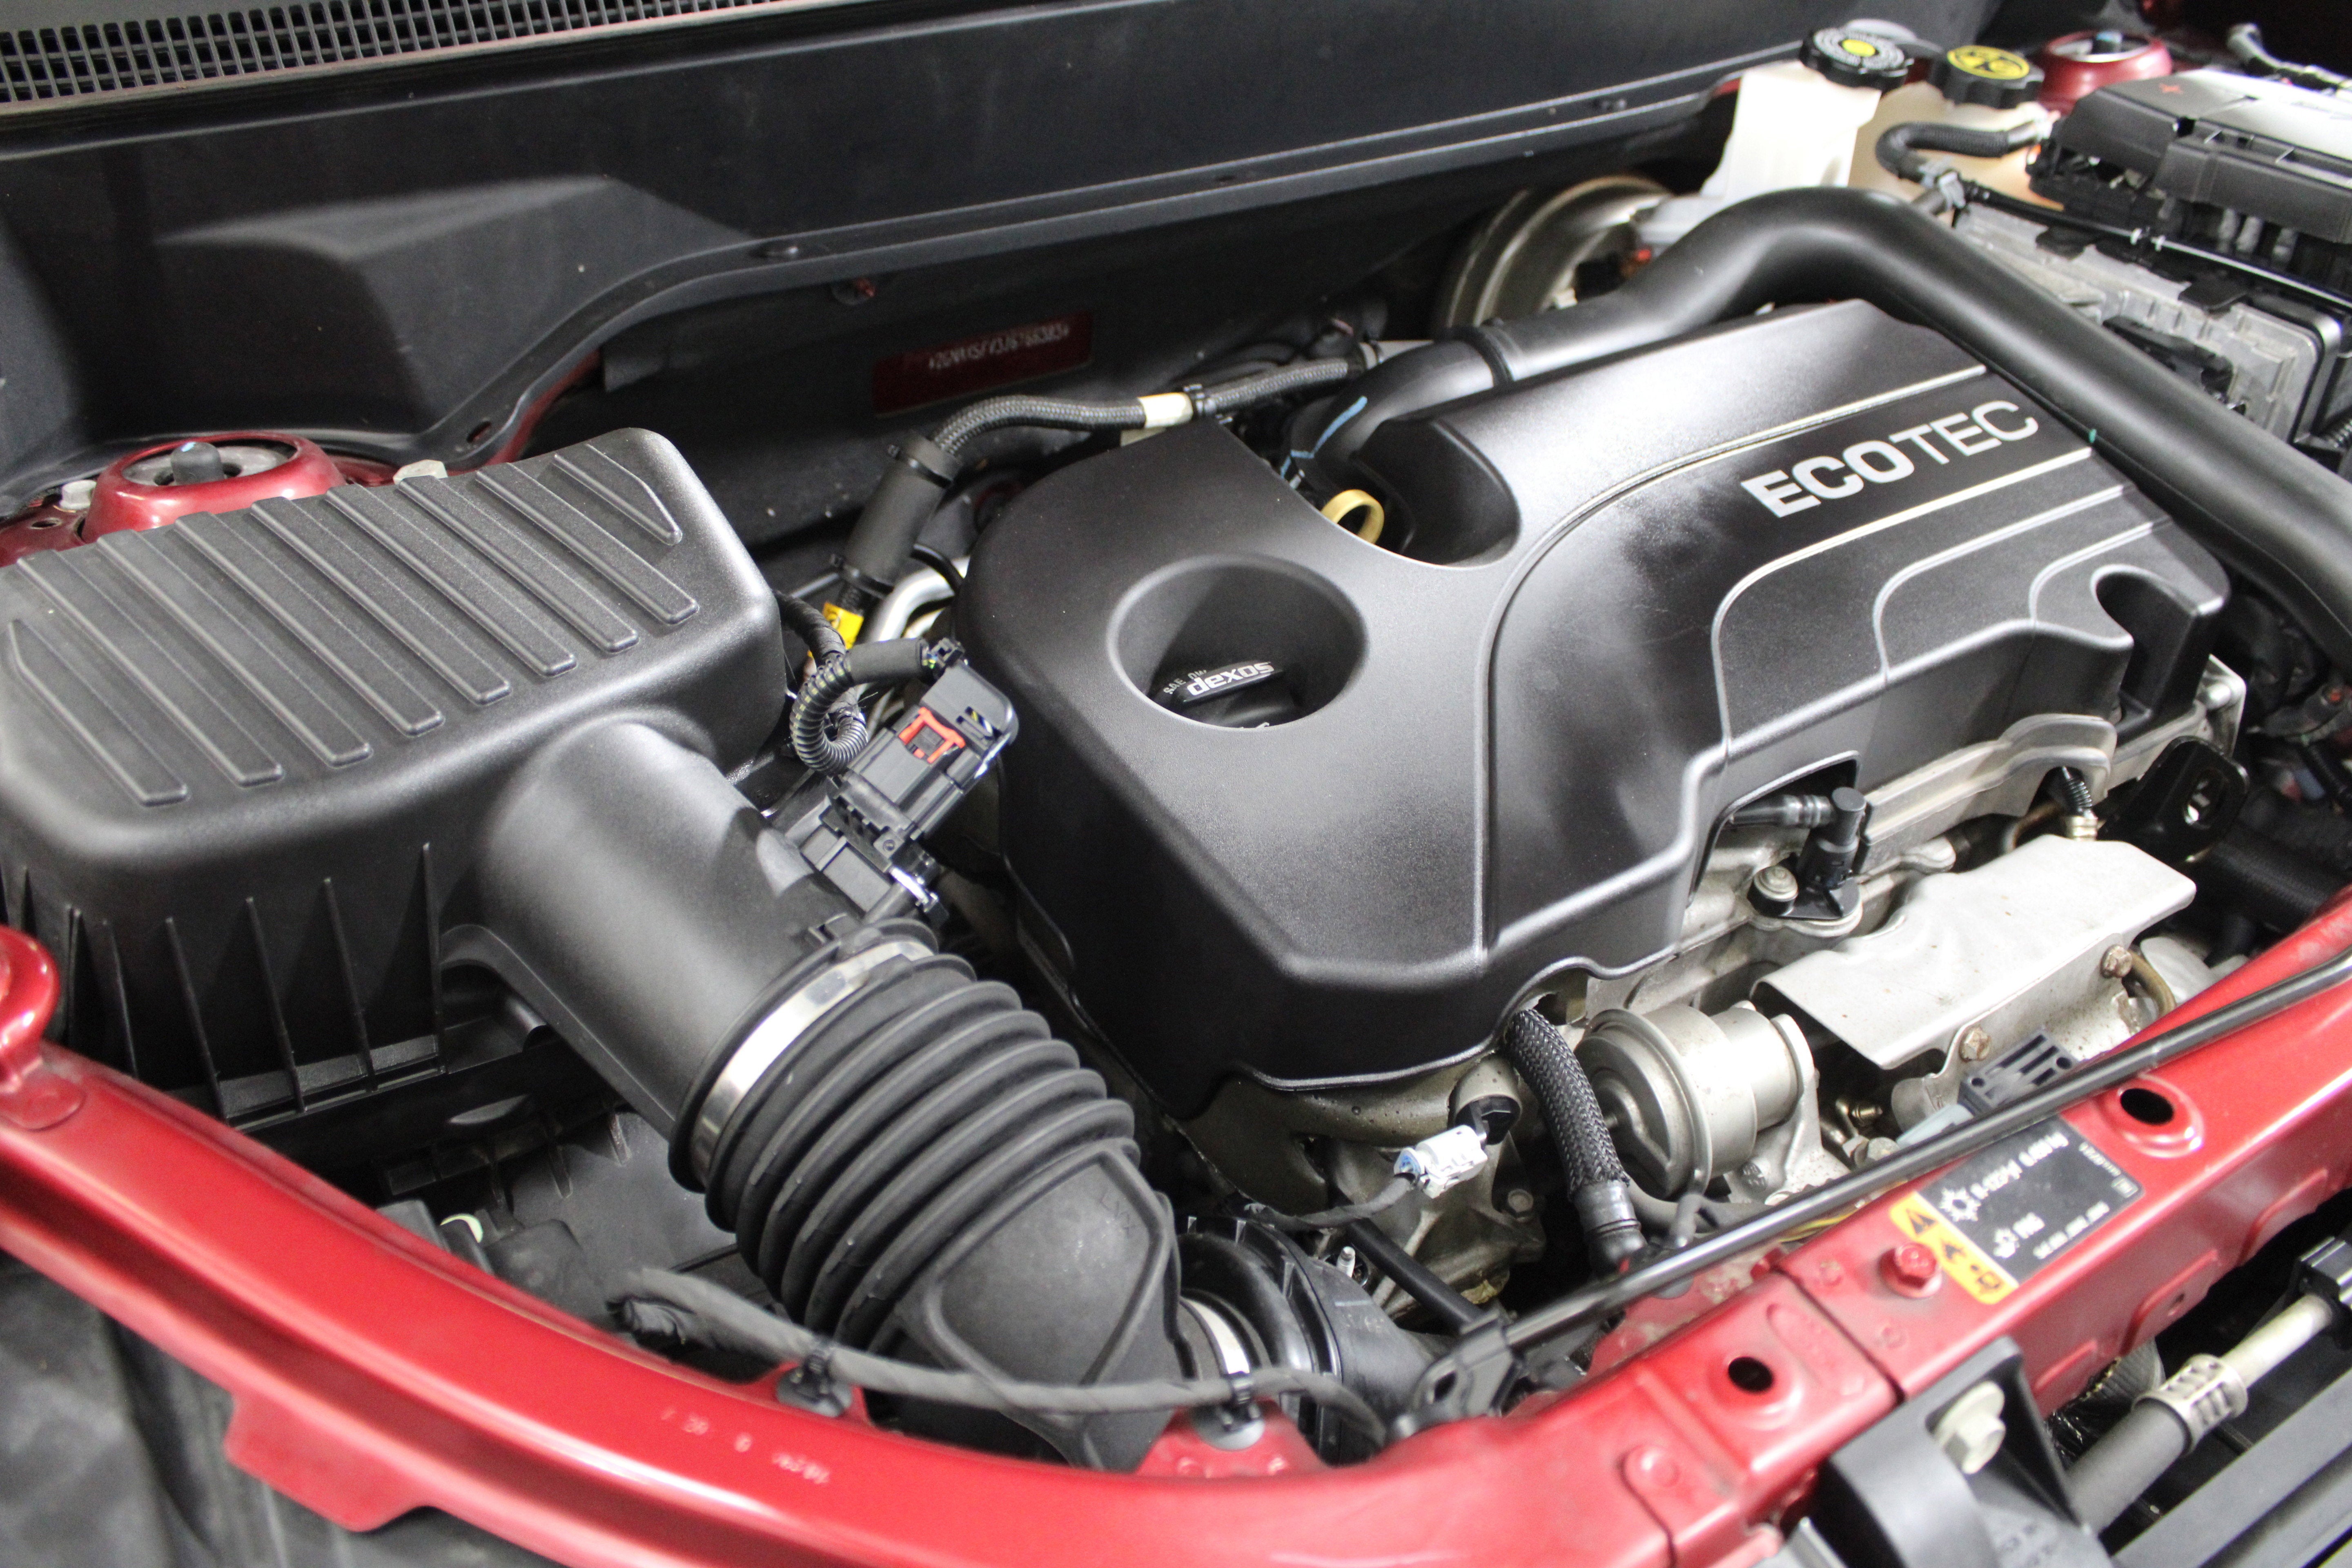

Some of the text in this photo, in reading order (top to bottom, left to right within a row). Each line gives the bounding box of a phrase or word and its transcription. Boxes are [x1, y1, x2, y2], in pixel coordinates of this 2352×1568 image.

[1740, 400, 2039, 518] ECOTEC
[1163, 677, 1187, 693] SAE
[1186, 661, 1274, 696] dexos
